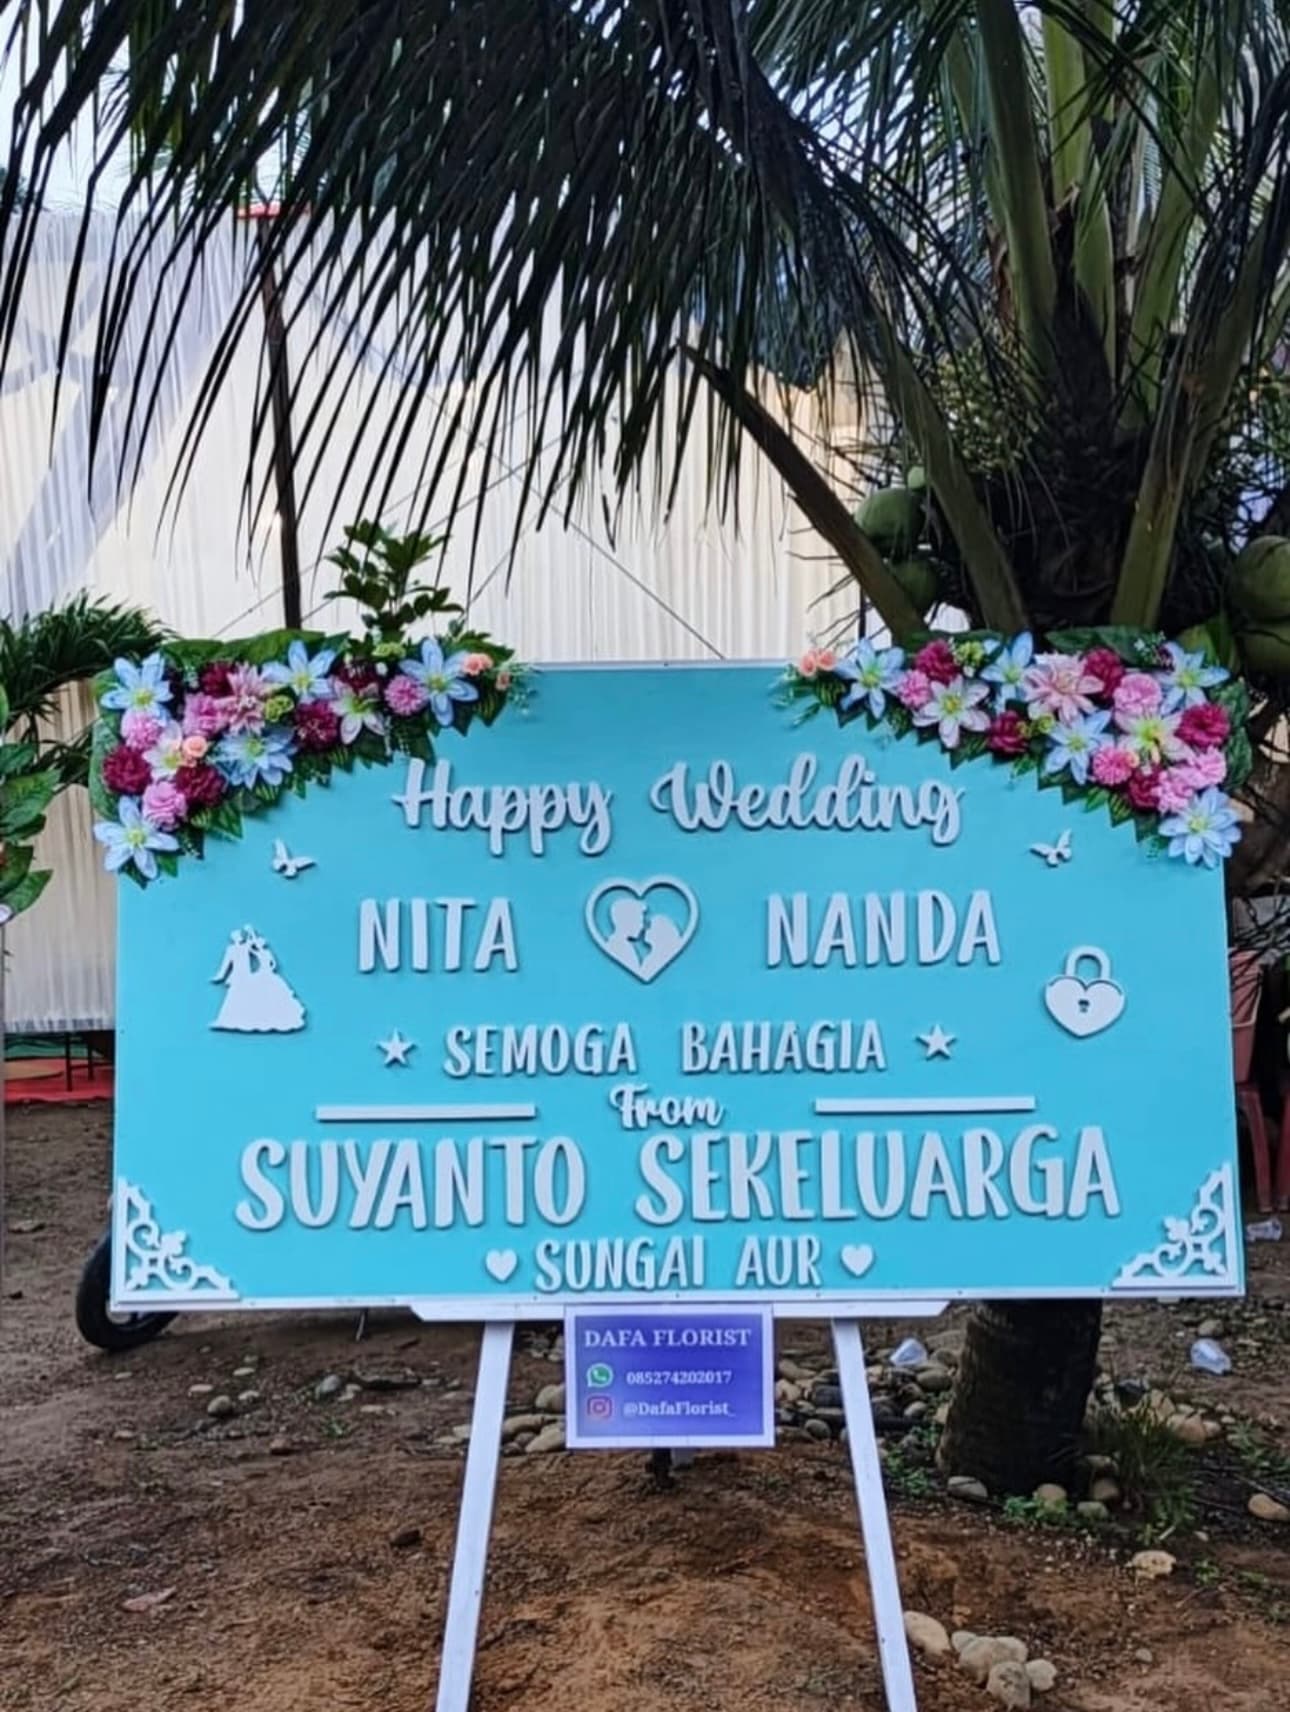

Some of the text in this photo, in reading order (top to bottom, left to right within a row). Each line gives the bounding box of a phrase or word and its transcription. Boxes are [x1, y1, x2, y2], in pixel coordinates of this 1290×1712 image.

[391, 753, 965, 856] Happy Wedding
[358, 897, 519, 973] NITA
[766, 890, 1001, 968] NANDA
[443, 1019, 886, 1078] SEMOGA BAHAGIA
[608, 1083, 725, 1130] From
[234, 1125, 1122, 1231] SUYANTO SEKELUARGA
[534, 1234, 822, 1293] SUNGAI AUR
[584, 1328, 752, 1347] DAFA FLORIST
[626, 1371, 733, 1385] 085274202017
